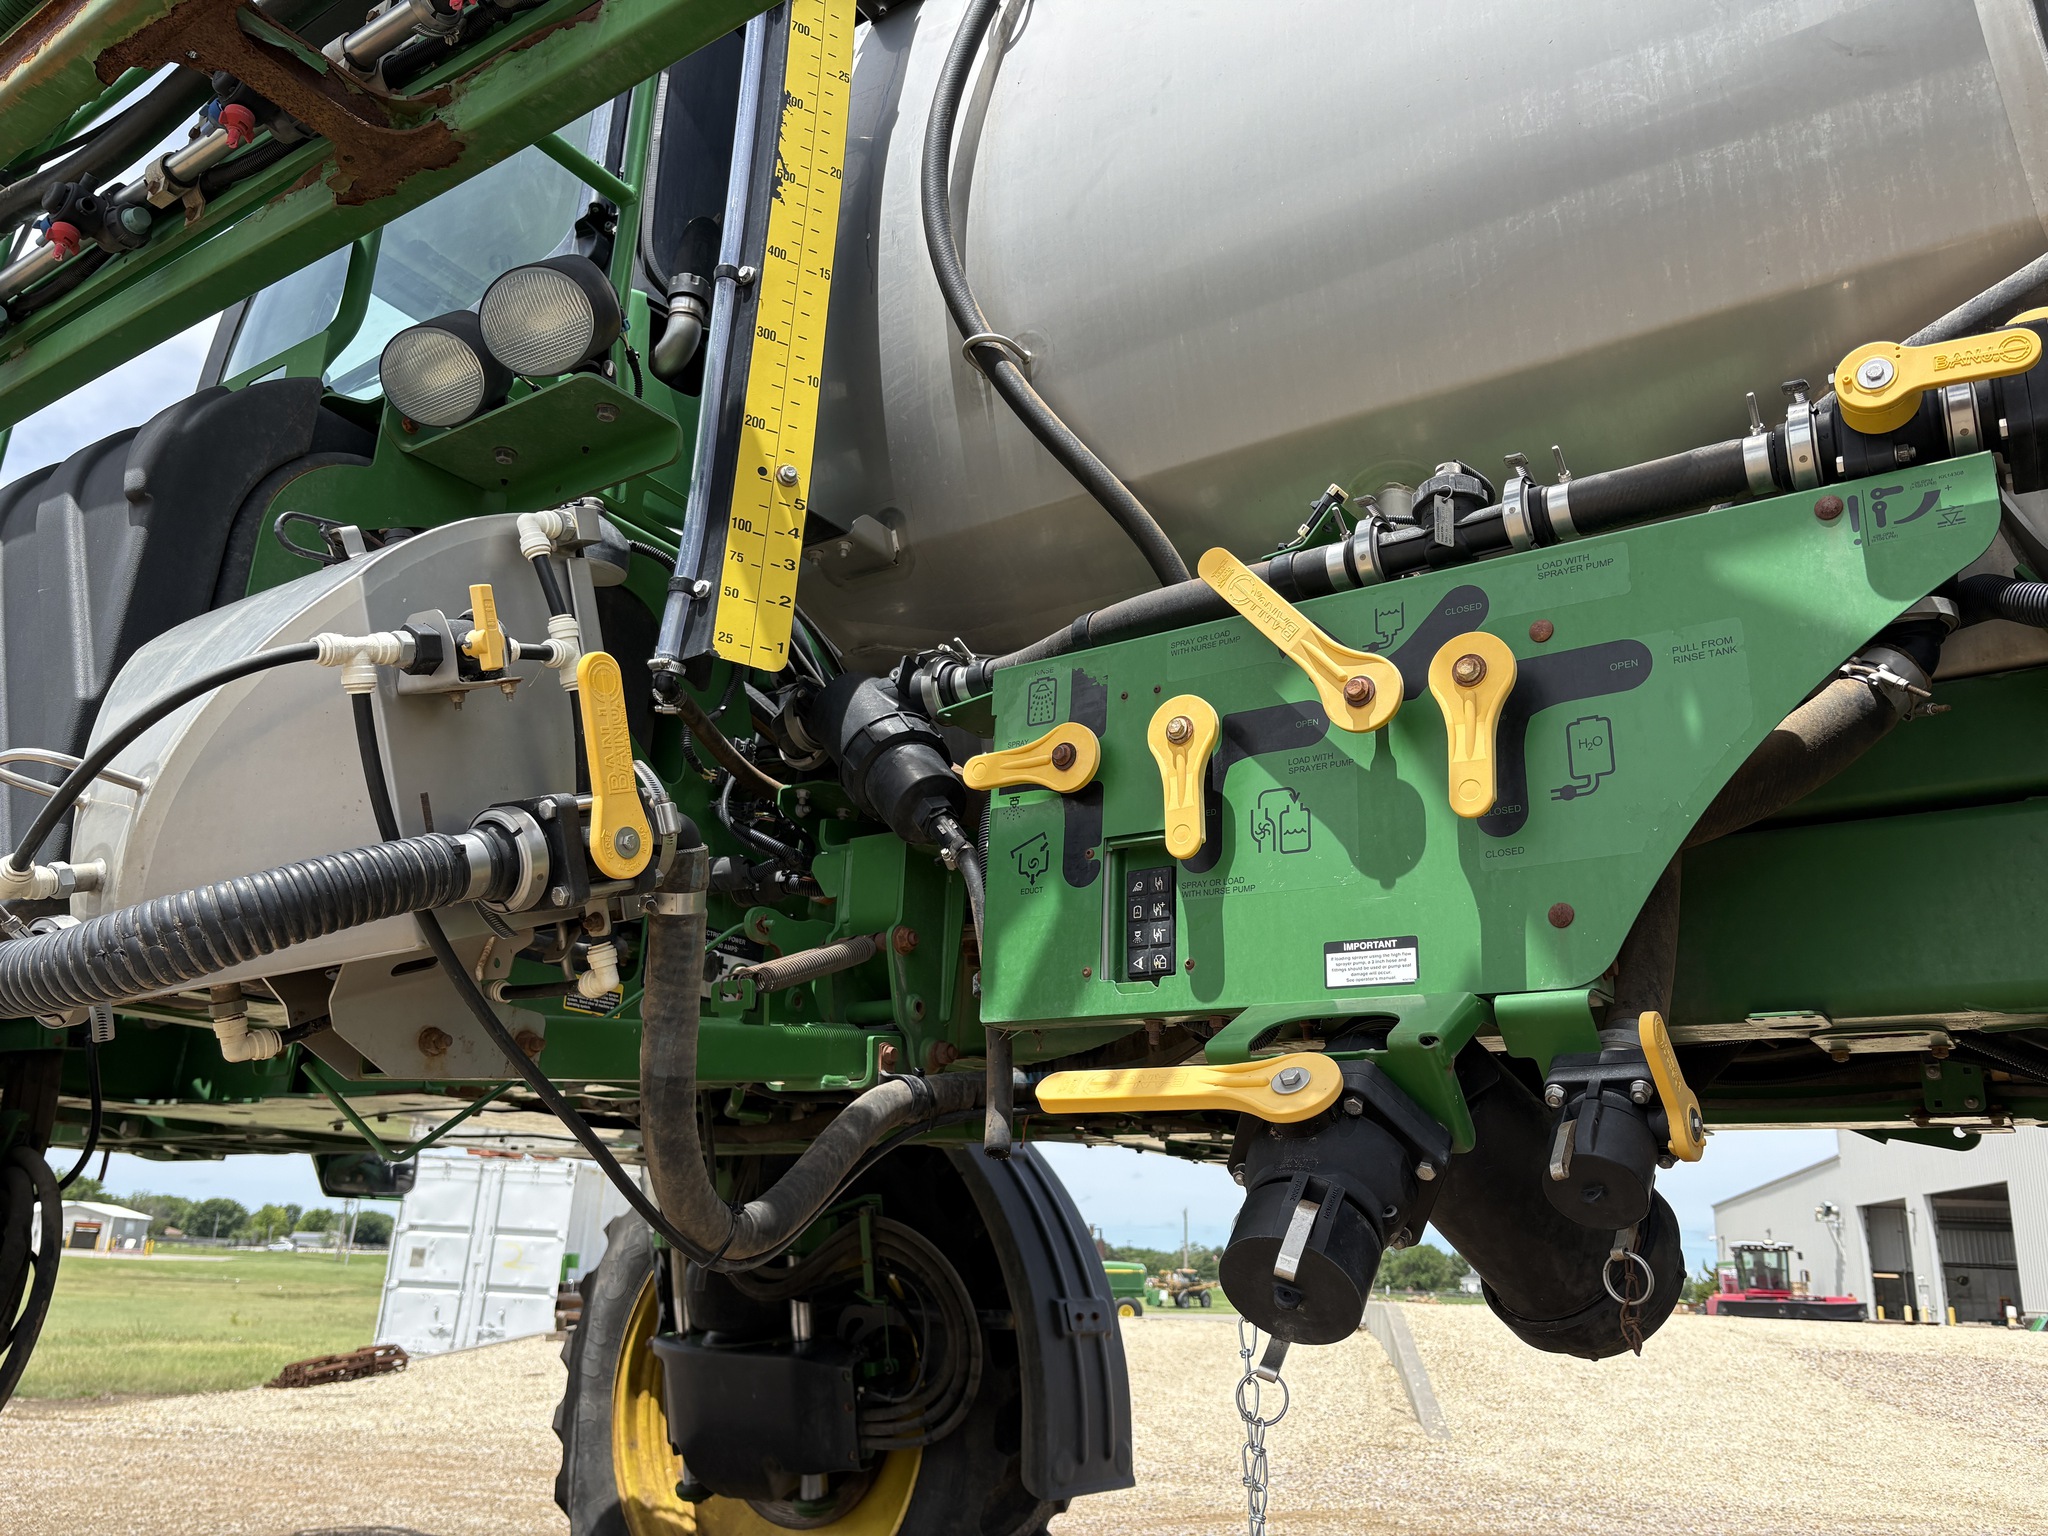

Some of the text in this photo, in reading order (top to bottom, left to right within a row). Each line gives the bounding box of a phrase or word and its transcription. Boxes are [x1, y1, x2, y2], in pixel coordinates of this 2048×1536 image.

[792, 20, 810, 36] 700
[838, 70, 850, 83] 25
[777, 168, 796, 183] 500
[830, 168, 842, 179] 20
[768, 246, 787, 260] 400
[819, 268, 830, 280] 15
[757, 326, 777, 341] 300
[807, 376, 819, 388] 10
[745, 415, 765, 430] 200
[794, 498, 806, 511] 5
[732, 518, 752, 533] 100
[787, 527, 800, 540] 4
[729, 550, 744, 563] 75
[1536, 553, 1590, 571] LOAD WITH
[784, 559, 796, 571] 3
[1537, 557, 1614, 580] SPRAYER PUMP
[724, 587, 739, 599] 50
[778, 595, 791, 608] 2
[1444, 602, 1482, 616] CLOSED
[718, 632, 733, 644] 25
[1171, 630, 1230, 649] SPRAY OR LOAD
[776, 642, 784, 654] 1
[1171, 636, 1240, 656] WITH NURSE PUMP
[1672, 636, 1733, 655] PULL FROM
[1673, 645, 1738, 664] RINSE TANK
[1609, 659, 1638, 671] OPEN
[1296, 718, 1319, 729] OPEN
[1007, 739, 1029, 749] SPRAY
[1288, 752, 1334, 766] LOAD WITH
[1289, 758, 1354, 774] SPRAYER PUMP
[1485, 846, 1525, 859] CLOSED
[1181, 876, 1245, 890] SPRAY OR LOAD
[1020, 886, 1044, 896] EDUCT
[1181, 884, 1256, 898] WITH NURSE PUMP
[1343, 939, 1398, 952] IMPORTANT
